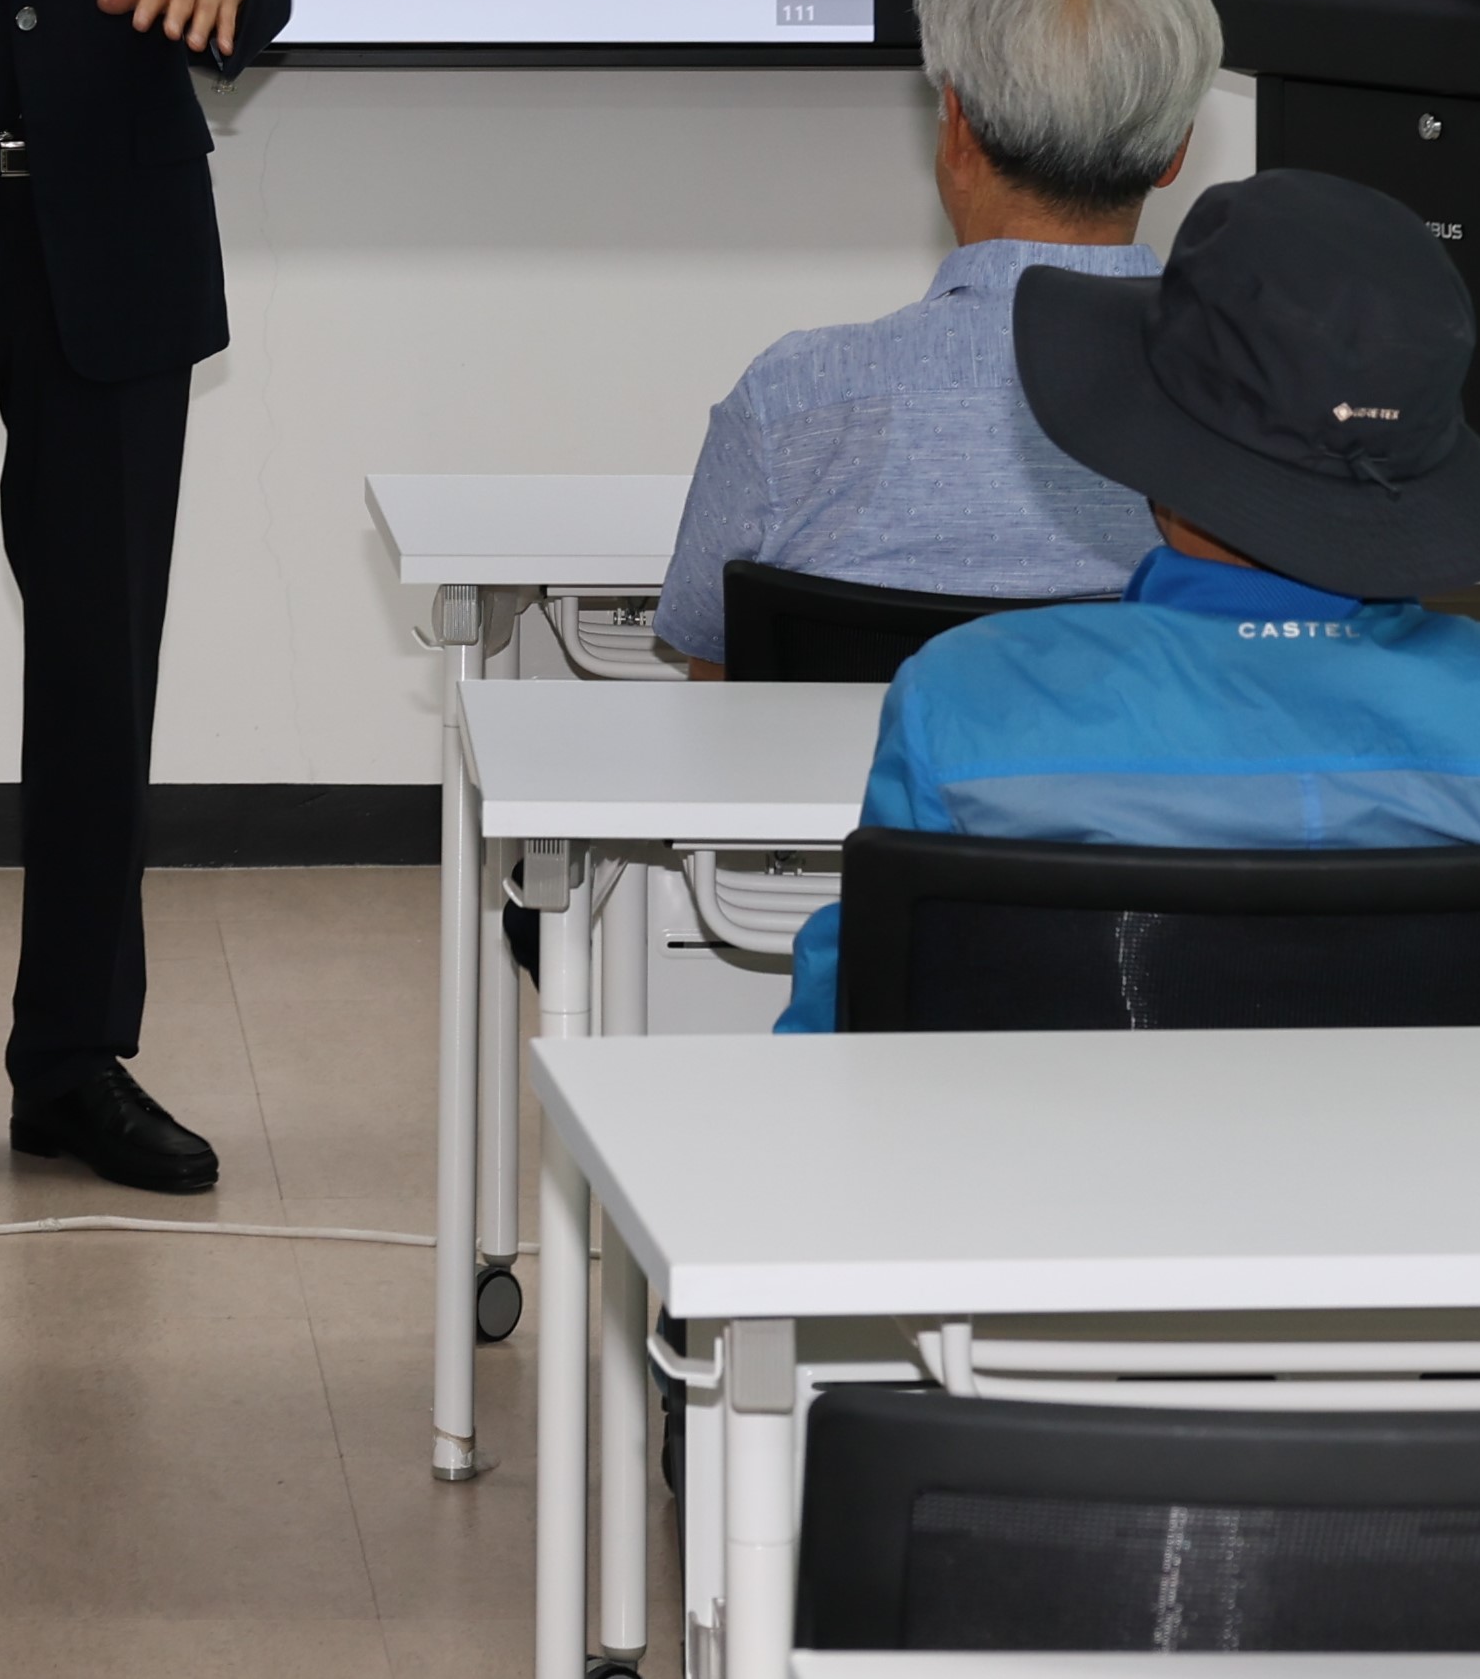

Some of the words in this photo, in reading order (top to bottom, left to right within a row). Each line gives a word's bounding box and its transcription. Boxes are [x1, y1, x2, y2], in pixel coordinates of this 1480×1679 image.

[783, 5, 815, 21] 111
[1425, 221, 1463, 240] BUS
[1238, 622, 1360, 639] CASTEL
